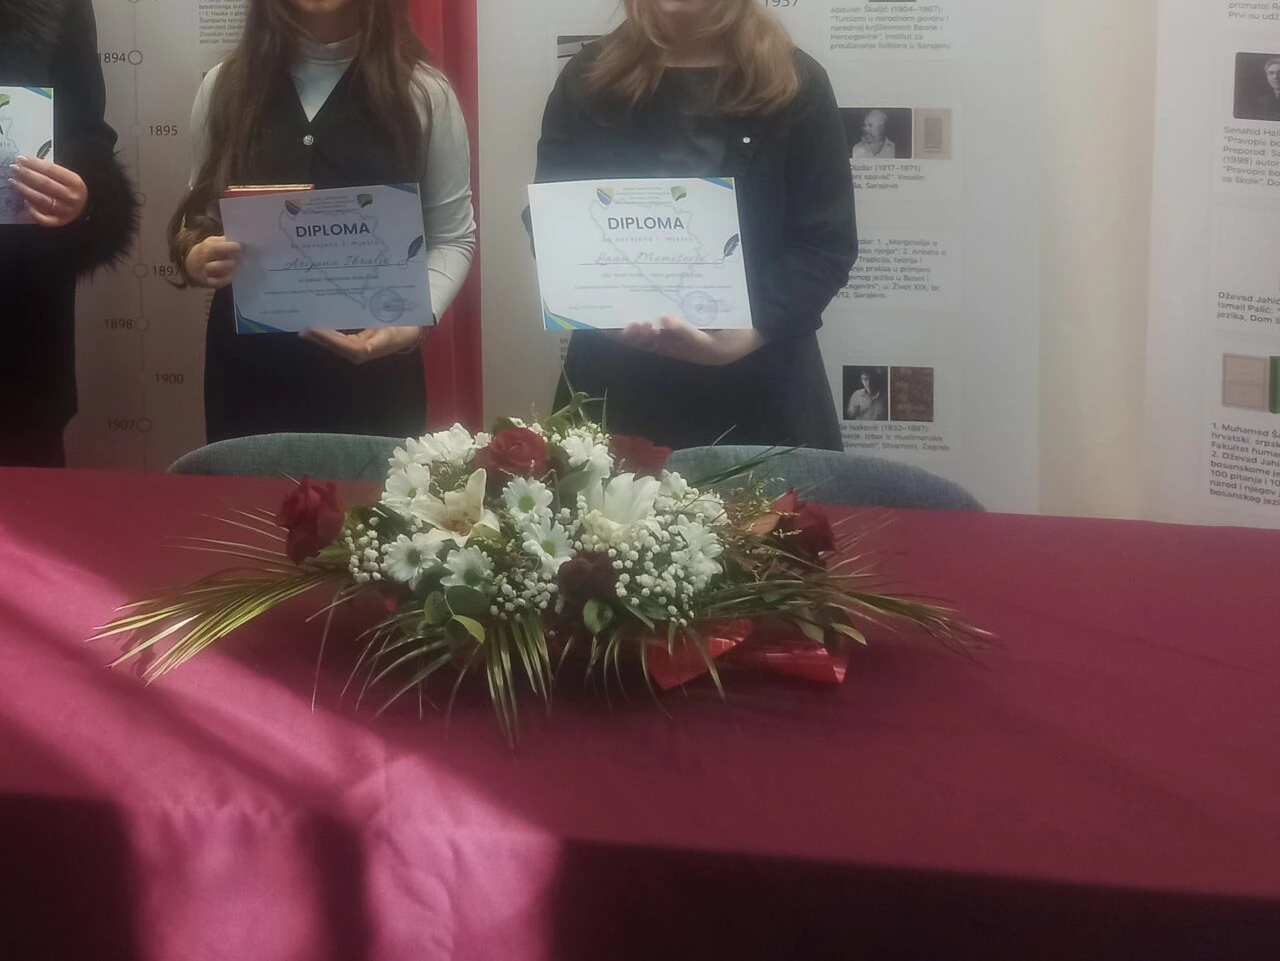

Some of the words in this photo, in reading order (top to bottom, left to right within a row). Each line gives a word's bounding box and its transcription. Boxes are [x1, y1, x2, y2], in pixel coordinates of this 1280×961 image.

[97, 52, 126, 63] 1894
[149, 125, 178, 136] 1895
[607, 216, 685, 230] DIPLOMA
[295, 222, 370, 238] DIPLOMA
[152, 265, 179, 277] 1897
[1218, 291, 1254, 302] Dževad
[1250, 314, 1273, 323] Dom
[104, 319, 133, 330] 1898
[154, 374, 183, 385] 1900
[1222, 423, 1269, 437] Muhamed
[1211, 441, 1249, 453] Fakultet
[1255, 439, 1280, 449] srpsk
[1222, 451, 1258, 464] Dževad
[1260, 458, 1280, 467] Jahi
[1210, 469, 1228, 478] 100
[1210, 480, 1237, 489] narod
[1210, 488, 1261, 504] bosanskog
